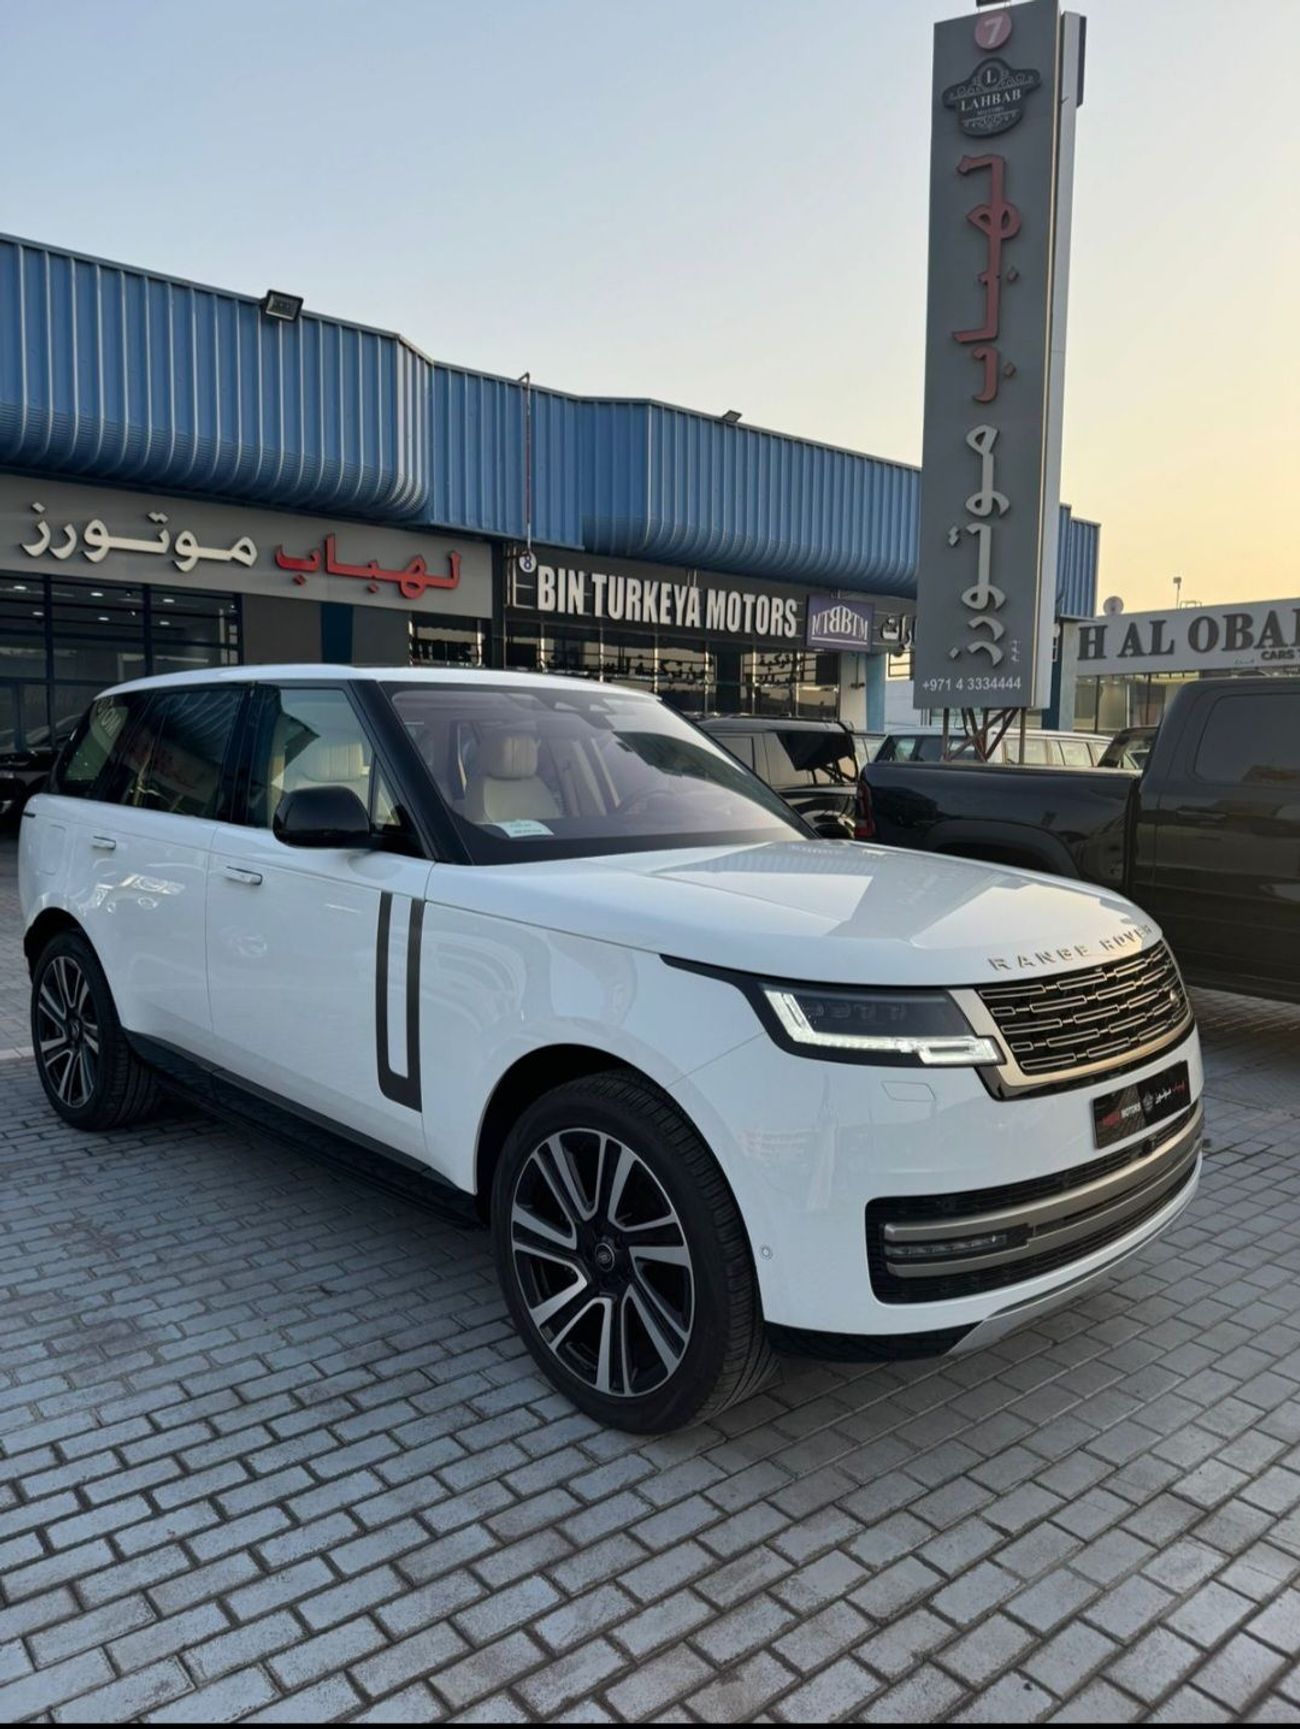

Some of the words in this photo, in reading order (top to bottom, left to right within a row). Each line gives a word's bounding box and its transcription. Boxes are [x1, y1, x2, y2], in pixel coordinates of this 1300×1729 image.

[985, 15, 1004, 45] 7
[986, 69, 997, 84] L
[961, 88, 1022, 112] LAHBAB
[952, 153, 1022, 403] لهباب
[21, 502, 259, 573] موتورز
[948, 423, 1010, 667] موتورز
[275, 533, 462, 600] لهباب
[537, 565, 585, 616] BIN
[590, 573, 701, 629] TURKEYA
[706, 588, 798, 639] MOTORS
[1117, 620, 1175, 658] AL
[1261, 649, 1295, 661] CARS
[922, 678, 952, 692] +971
[955, 678, 964, 691] 4
[967, 676, 1023, 691] 3334444
[988, 944, 1089, 971] RANGE
[1099, 925, 1153, 952] ROVER
